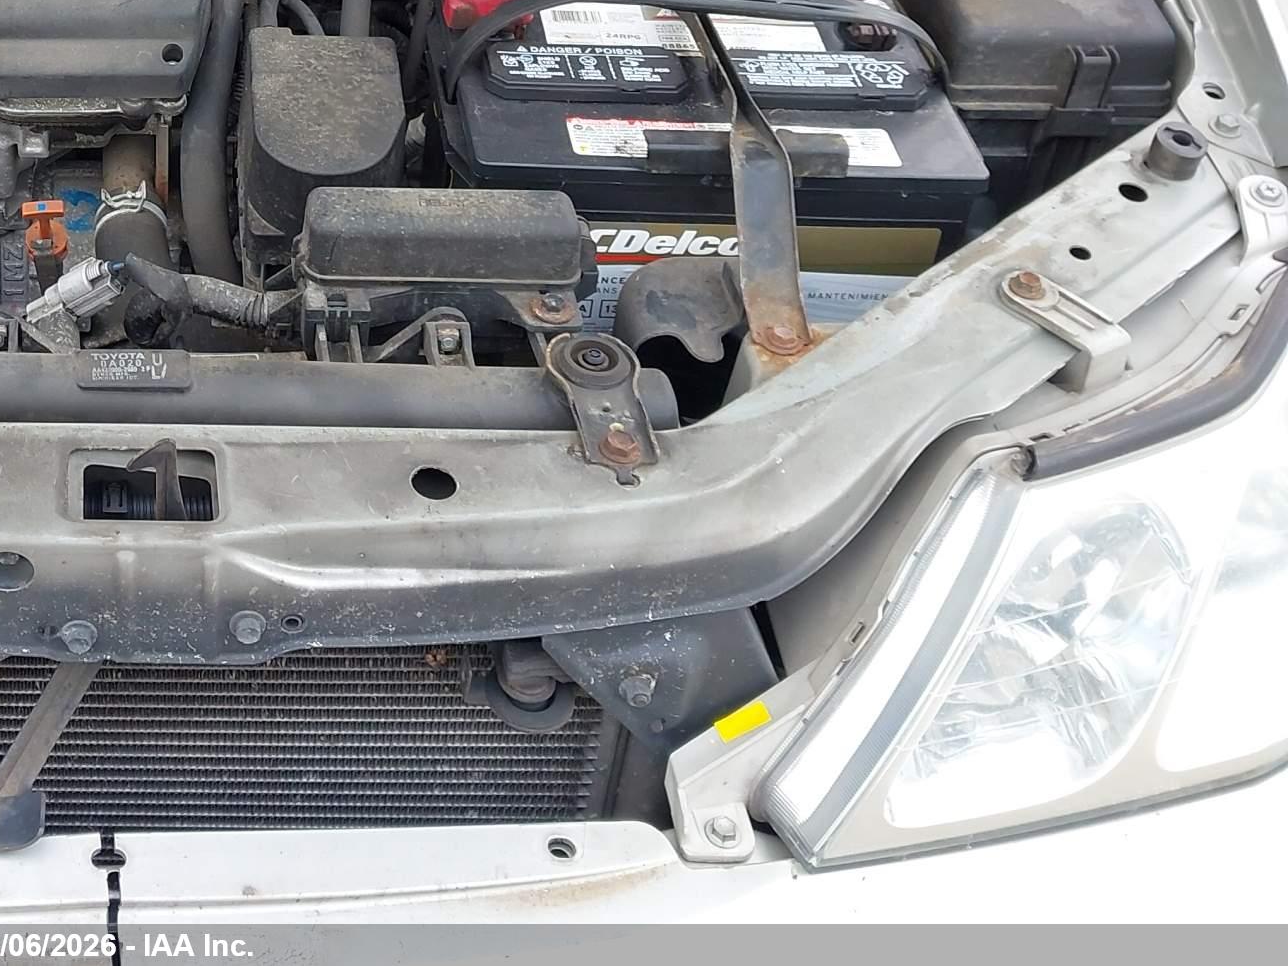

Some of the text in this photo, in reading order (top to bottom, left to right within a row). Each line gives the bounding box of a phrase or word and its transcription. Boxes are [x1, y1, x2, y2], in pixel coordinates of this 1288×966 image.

[530, 46, 582, 54] DANGER
[596, 48, 643, 56] POISON
[598, 276, 626, 284] NCE
[90, 352, 145, 360] TOYOTA
